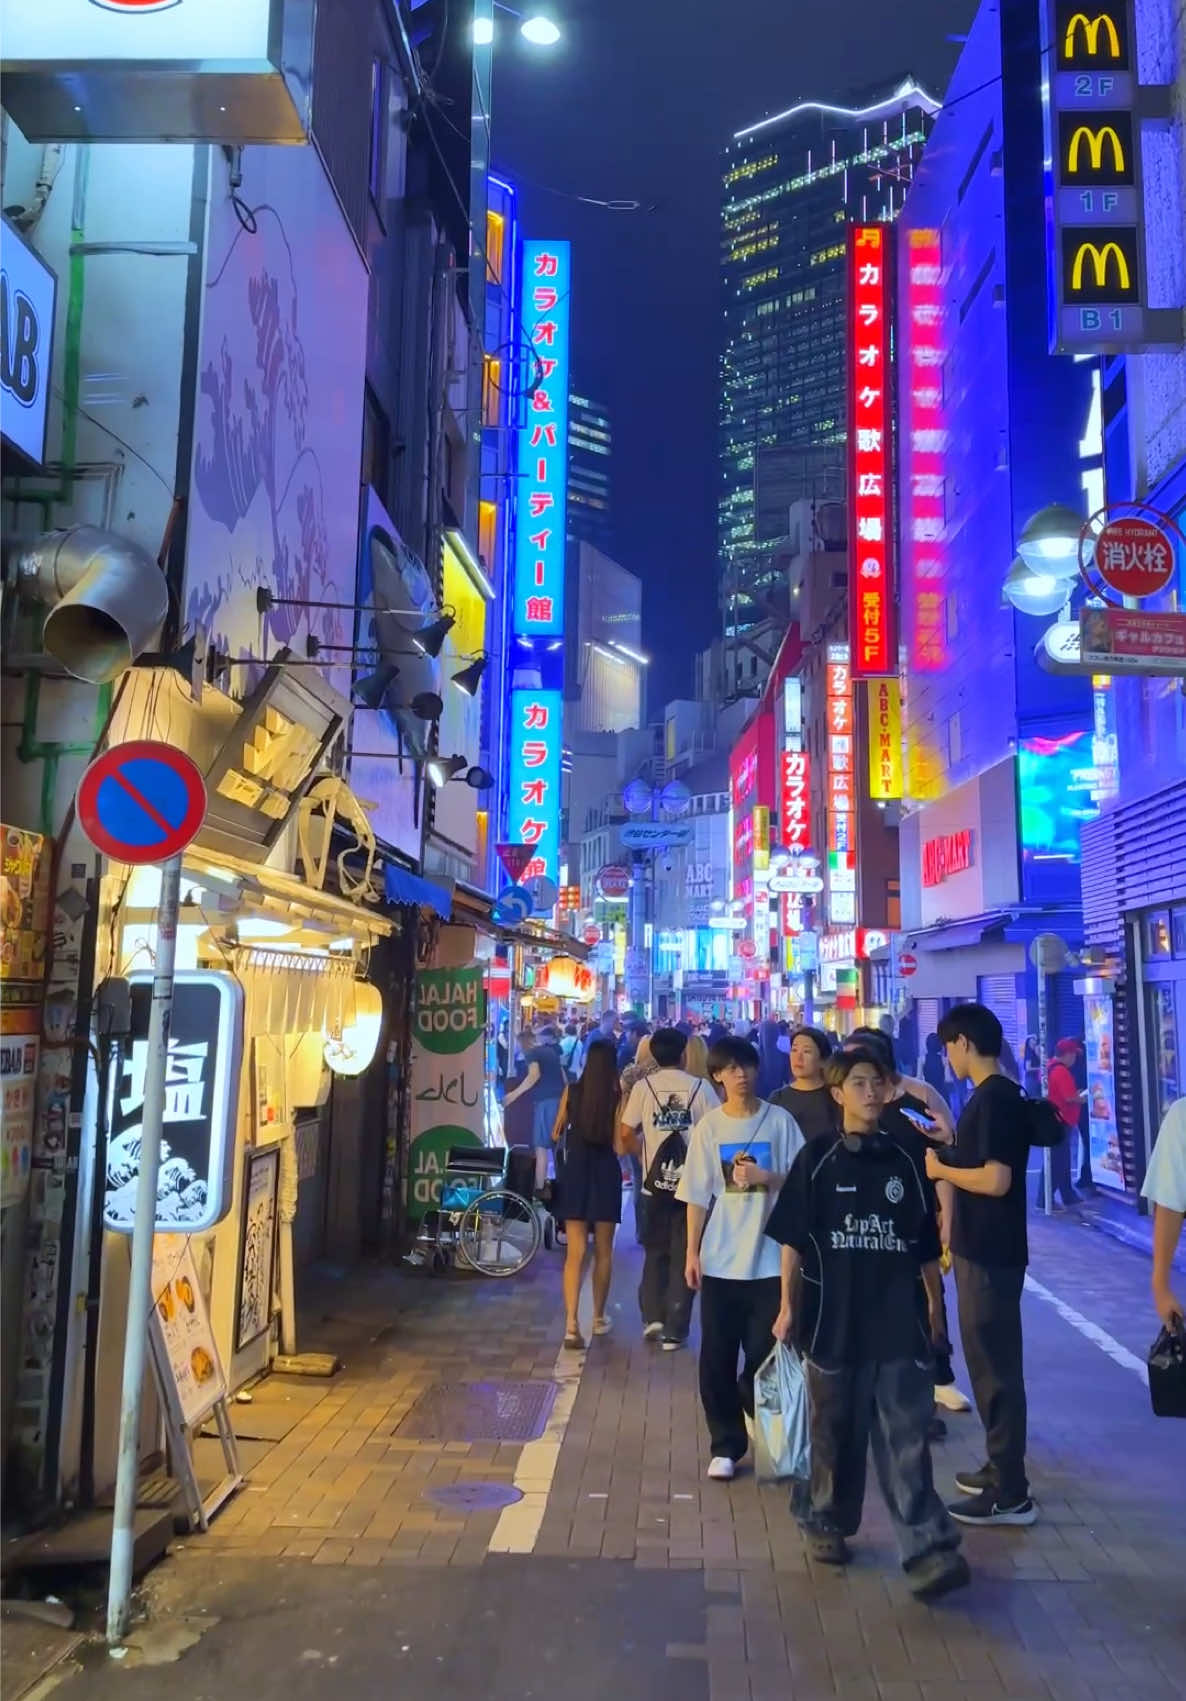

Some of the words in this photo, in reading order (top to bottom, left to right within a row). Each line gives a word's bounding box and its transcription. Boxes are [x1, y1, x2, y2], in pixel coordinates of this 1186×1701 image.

[1075, 77, 1113, 97] 2F
[1080, 192, 1118, 212] 1F
[1080, 309, 1122, 331] B1
[1102, 541, 1168, 573] 消火栓
[785, 753, 807, 841] カラオケ
[686, 863, 713, 883] ABC
[654, 1180, 678, 1192] adid
